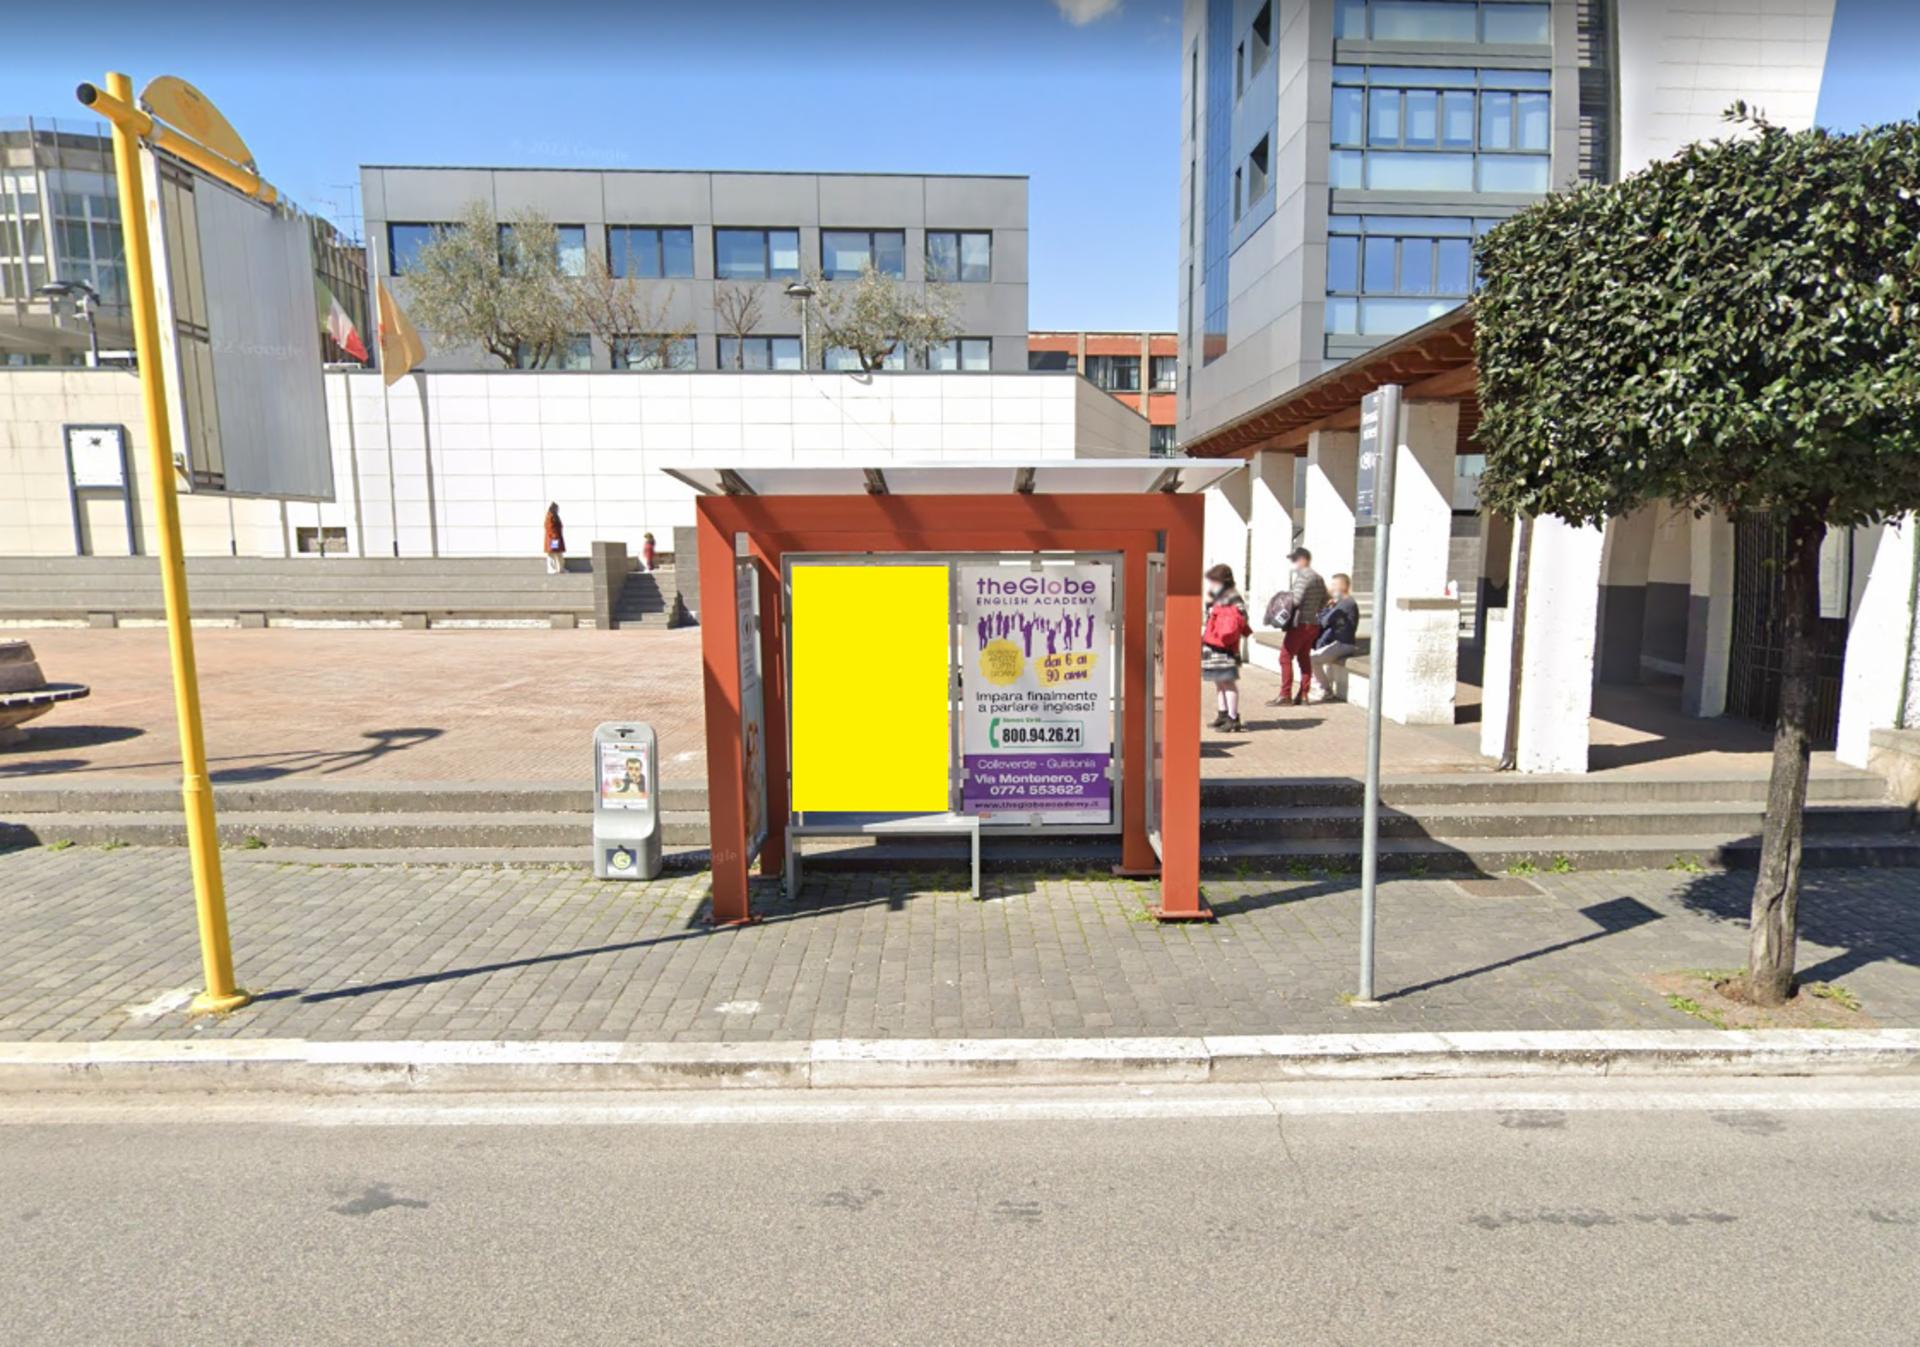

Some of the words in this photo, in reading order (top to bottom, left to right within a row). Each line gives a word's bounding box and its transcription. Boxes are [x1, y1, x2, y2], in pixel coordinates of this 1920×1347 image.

[977, 577, 1096, 595] theGlobe
[976, 597, 1028, 606] ENGLISH
[1034, 597, 1096, 605] ACADEMY
[976, 691, 1023, 703] Impara
[1027, 690, 1098, 701] finalmente
[978, 704, 986, 713] a
[990, 702, 1039, 714] parlare
[1043, 701, 1095, 714] inglese!
[1002, 727, 1080, 743] 800.94.26.21
[977, 759, 1037, 770] Colleverde
[1046, 758, 1096, 769] Guidonia
[975, 773, 996, 785] Via
[1000, 773, 1078, 784] Montenero,
[1081, 773, 1099, 783] 87
[990, 785, 1025, 796] 0774
[1029, 784, 1084, 796] 553622
